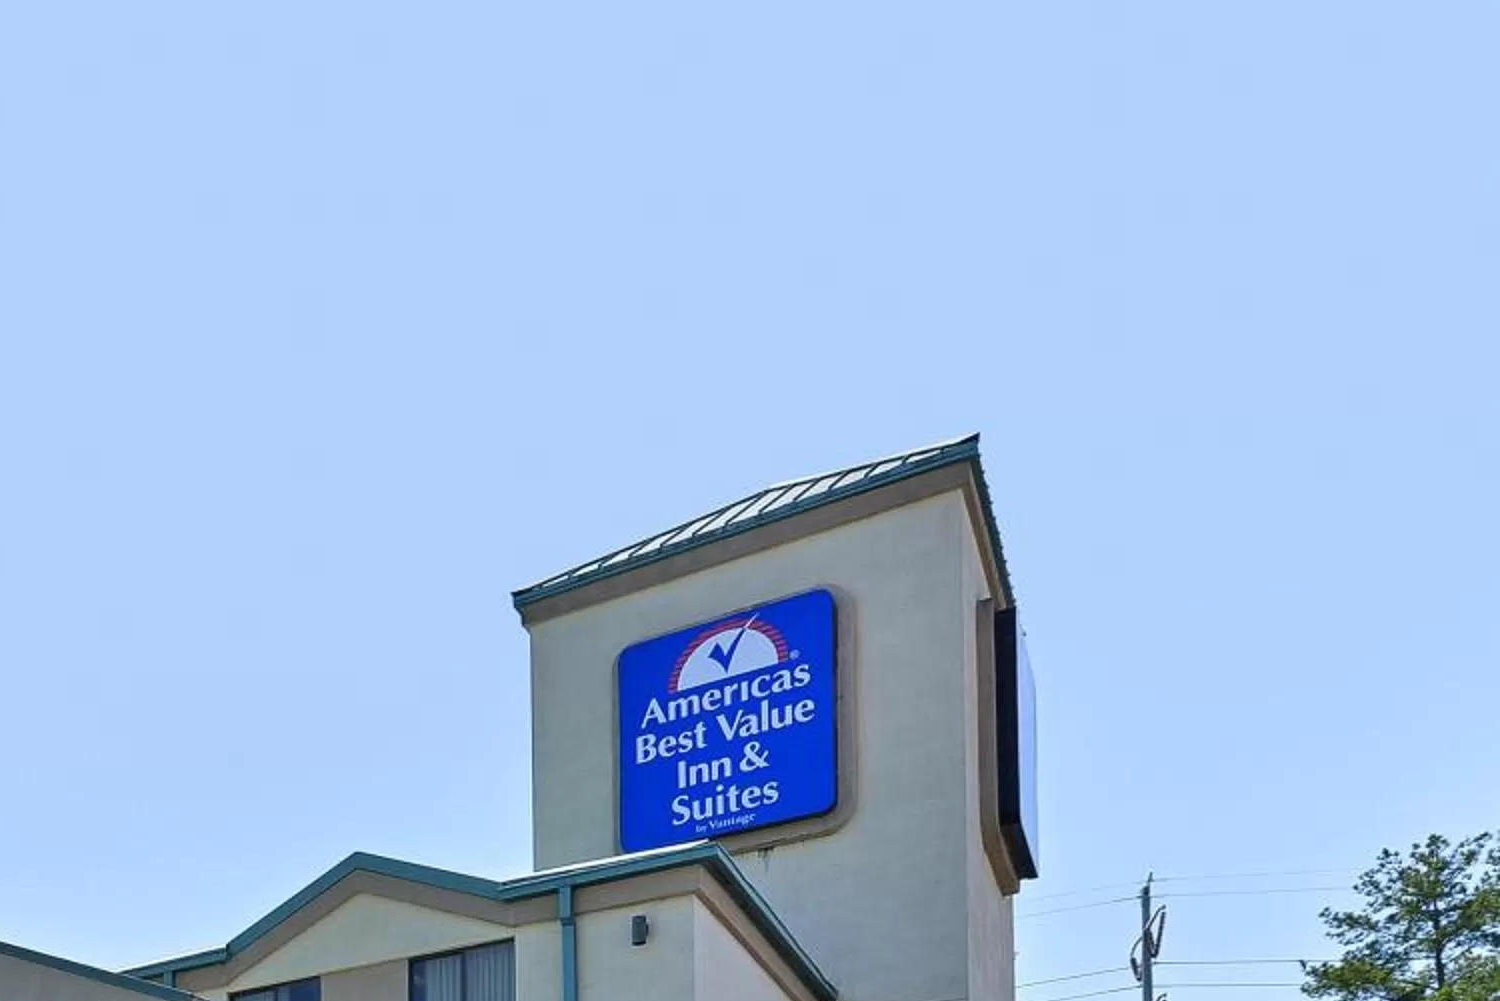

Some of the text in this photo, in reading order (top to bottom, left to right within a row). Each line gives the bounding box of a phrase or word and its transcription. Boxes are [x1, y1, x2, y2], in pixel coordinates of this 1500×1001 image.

[642, 665, 811, 728] Americas
[636, 699, 815, 764] Best Value
[677, 741, 769, 789] Inn &
[672, 781, 779, 825] Suites
